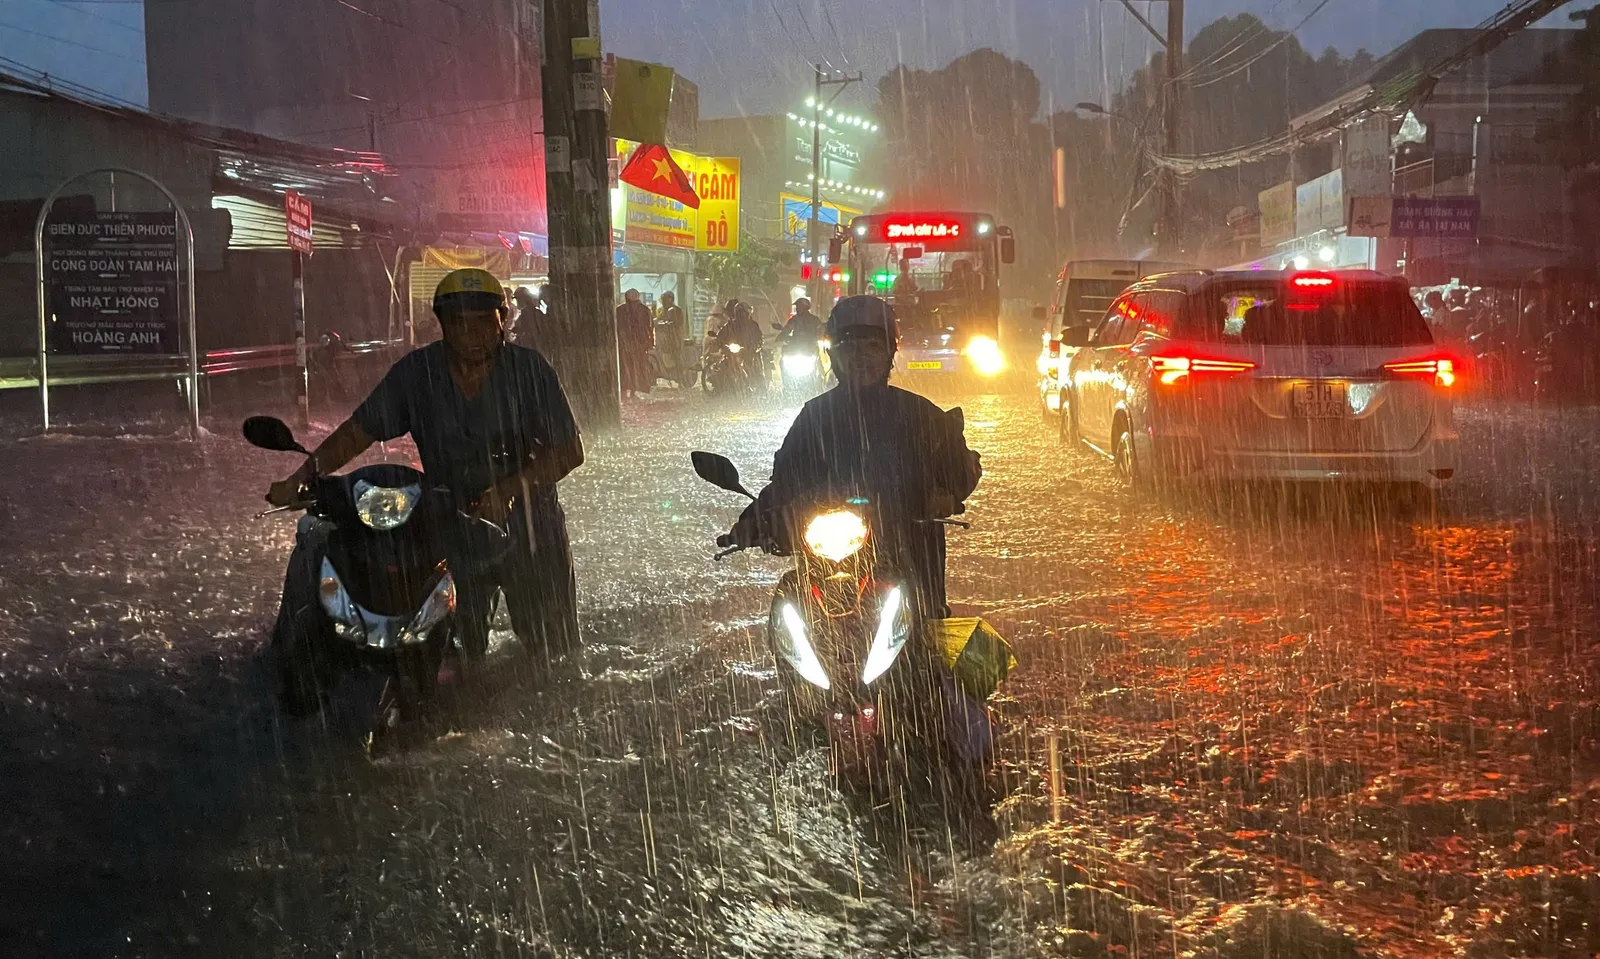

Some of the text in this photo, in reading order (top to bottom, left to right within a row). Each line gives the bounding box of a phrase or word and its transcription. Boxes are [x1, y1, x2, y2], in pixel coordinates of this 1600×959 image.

[128, 260, 153, 271] TAM
[72, 329, 160, 344] HOÀNG ANH
[1306, 386, 1332, 401] 51H
